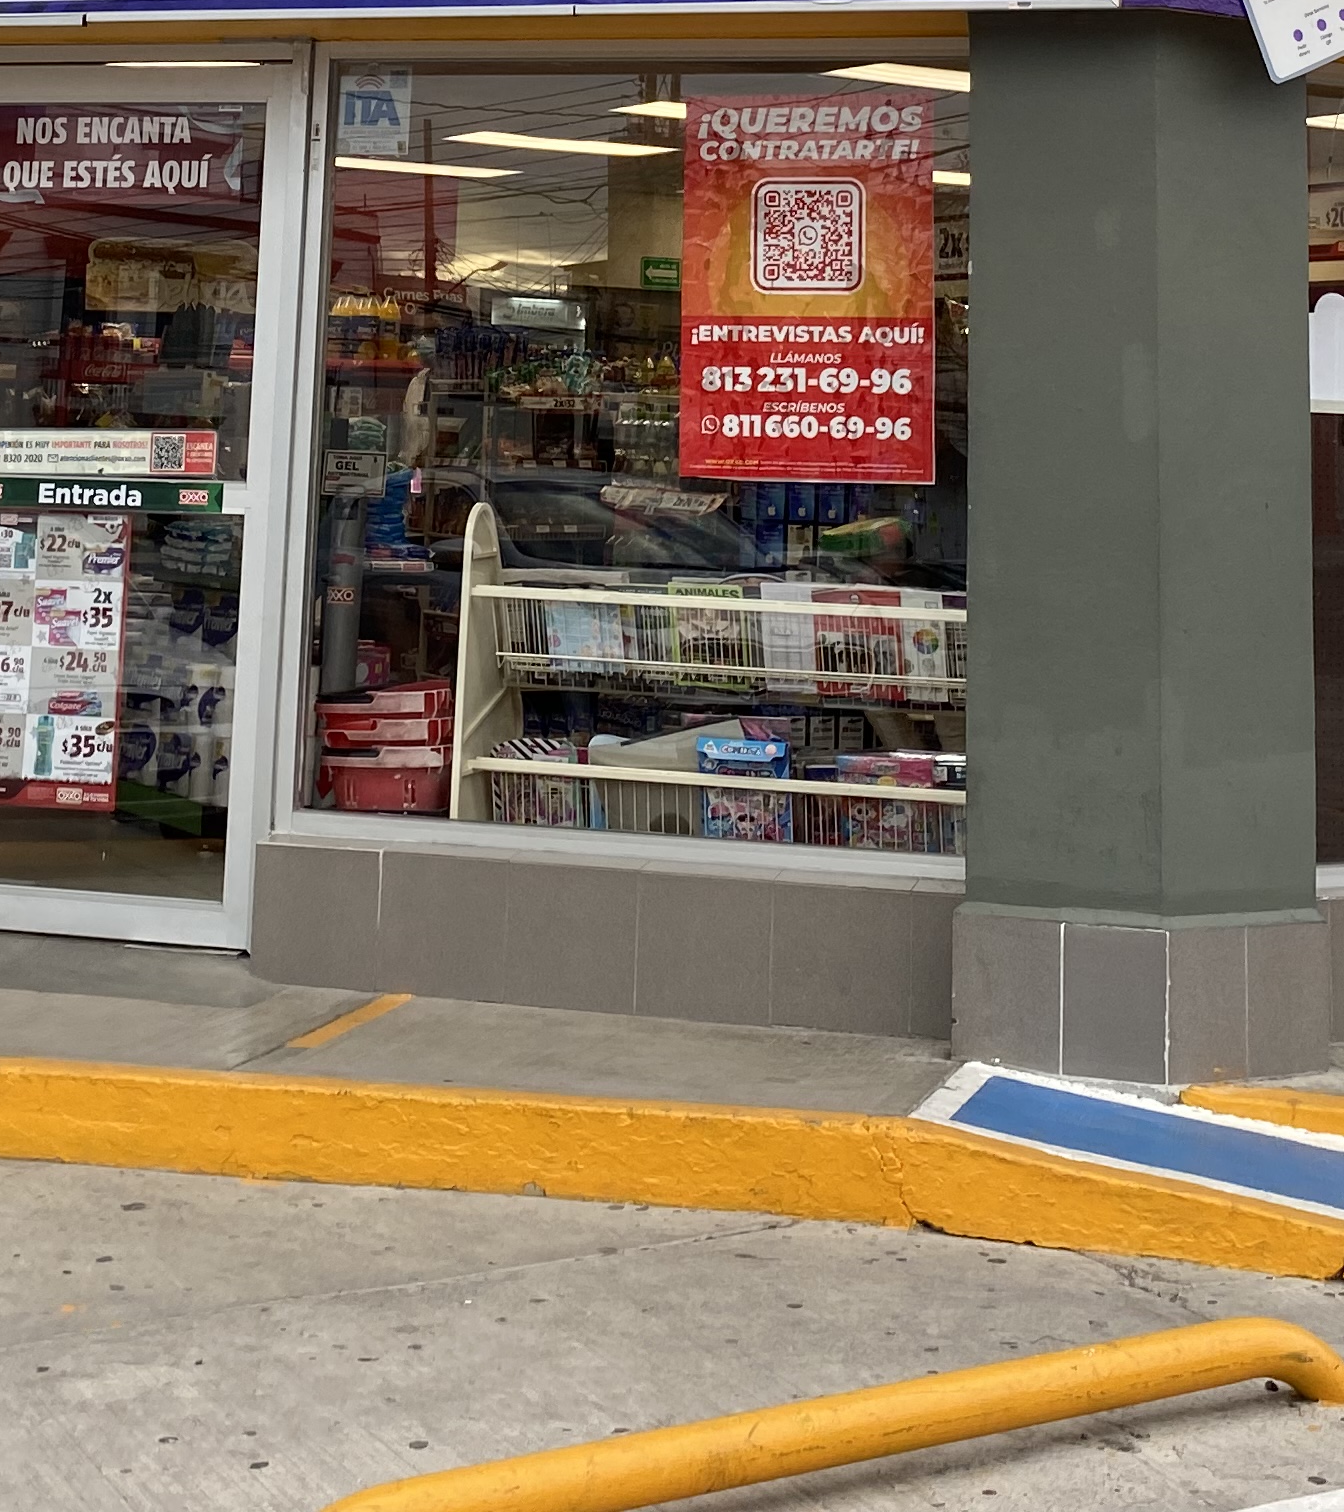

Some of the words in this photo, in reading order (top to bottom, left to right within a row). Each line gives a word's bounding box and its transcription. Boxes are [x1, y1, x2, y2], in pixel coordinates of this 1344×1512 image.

[15, 116, 66, 145] NOS
[75, 115, 191, 144] ENCANTA
[697, 104, 924, 141] ¡QUEREMOS
[699, 138, 919, 162] CONTRATARTE!
[2, 159, 58, 193] QUE
[62, 155, 136, 189] ESTÉS
[142, 153, 212, 196] AQUÍ
[691, 324, 853, 346] ¡ENTREVISTAS
[857, 322, 925, 347] AQUÍ!
[769, 350, 842, 365] LLÁMANOS
[701, 365, 753, 393] 813
[755, 366, 913, 395] 231-69-96
[762, 399, 846, 414] ESCRÍBENOS
[25, 441, 34, 449] ES
[35, 440, 50, 449] MUY
[51, 440, 92, 450] IMPORTANTE
[93, 441, 111, 450] PARA
[3, 454, 22, 464] 8320
[24, 454, 43, 464] 2020
[335, 460, 360, 471] GEL
[37, 482, 143, 507] Entrada
[179, 491, 209, 504] OXXO
[39, 533, 67, 553] $22
[88, 553, 121, 565] Premier
[328, 588, 354, 601] XXO
[14, 605, 30, 618] c/u
[82, 605, 114, 629] $35
[49, 700, 83, 711] Colgate
[61, 734, 96, 758] $35
[96, 741, 114, 753] c/u
